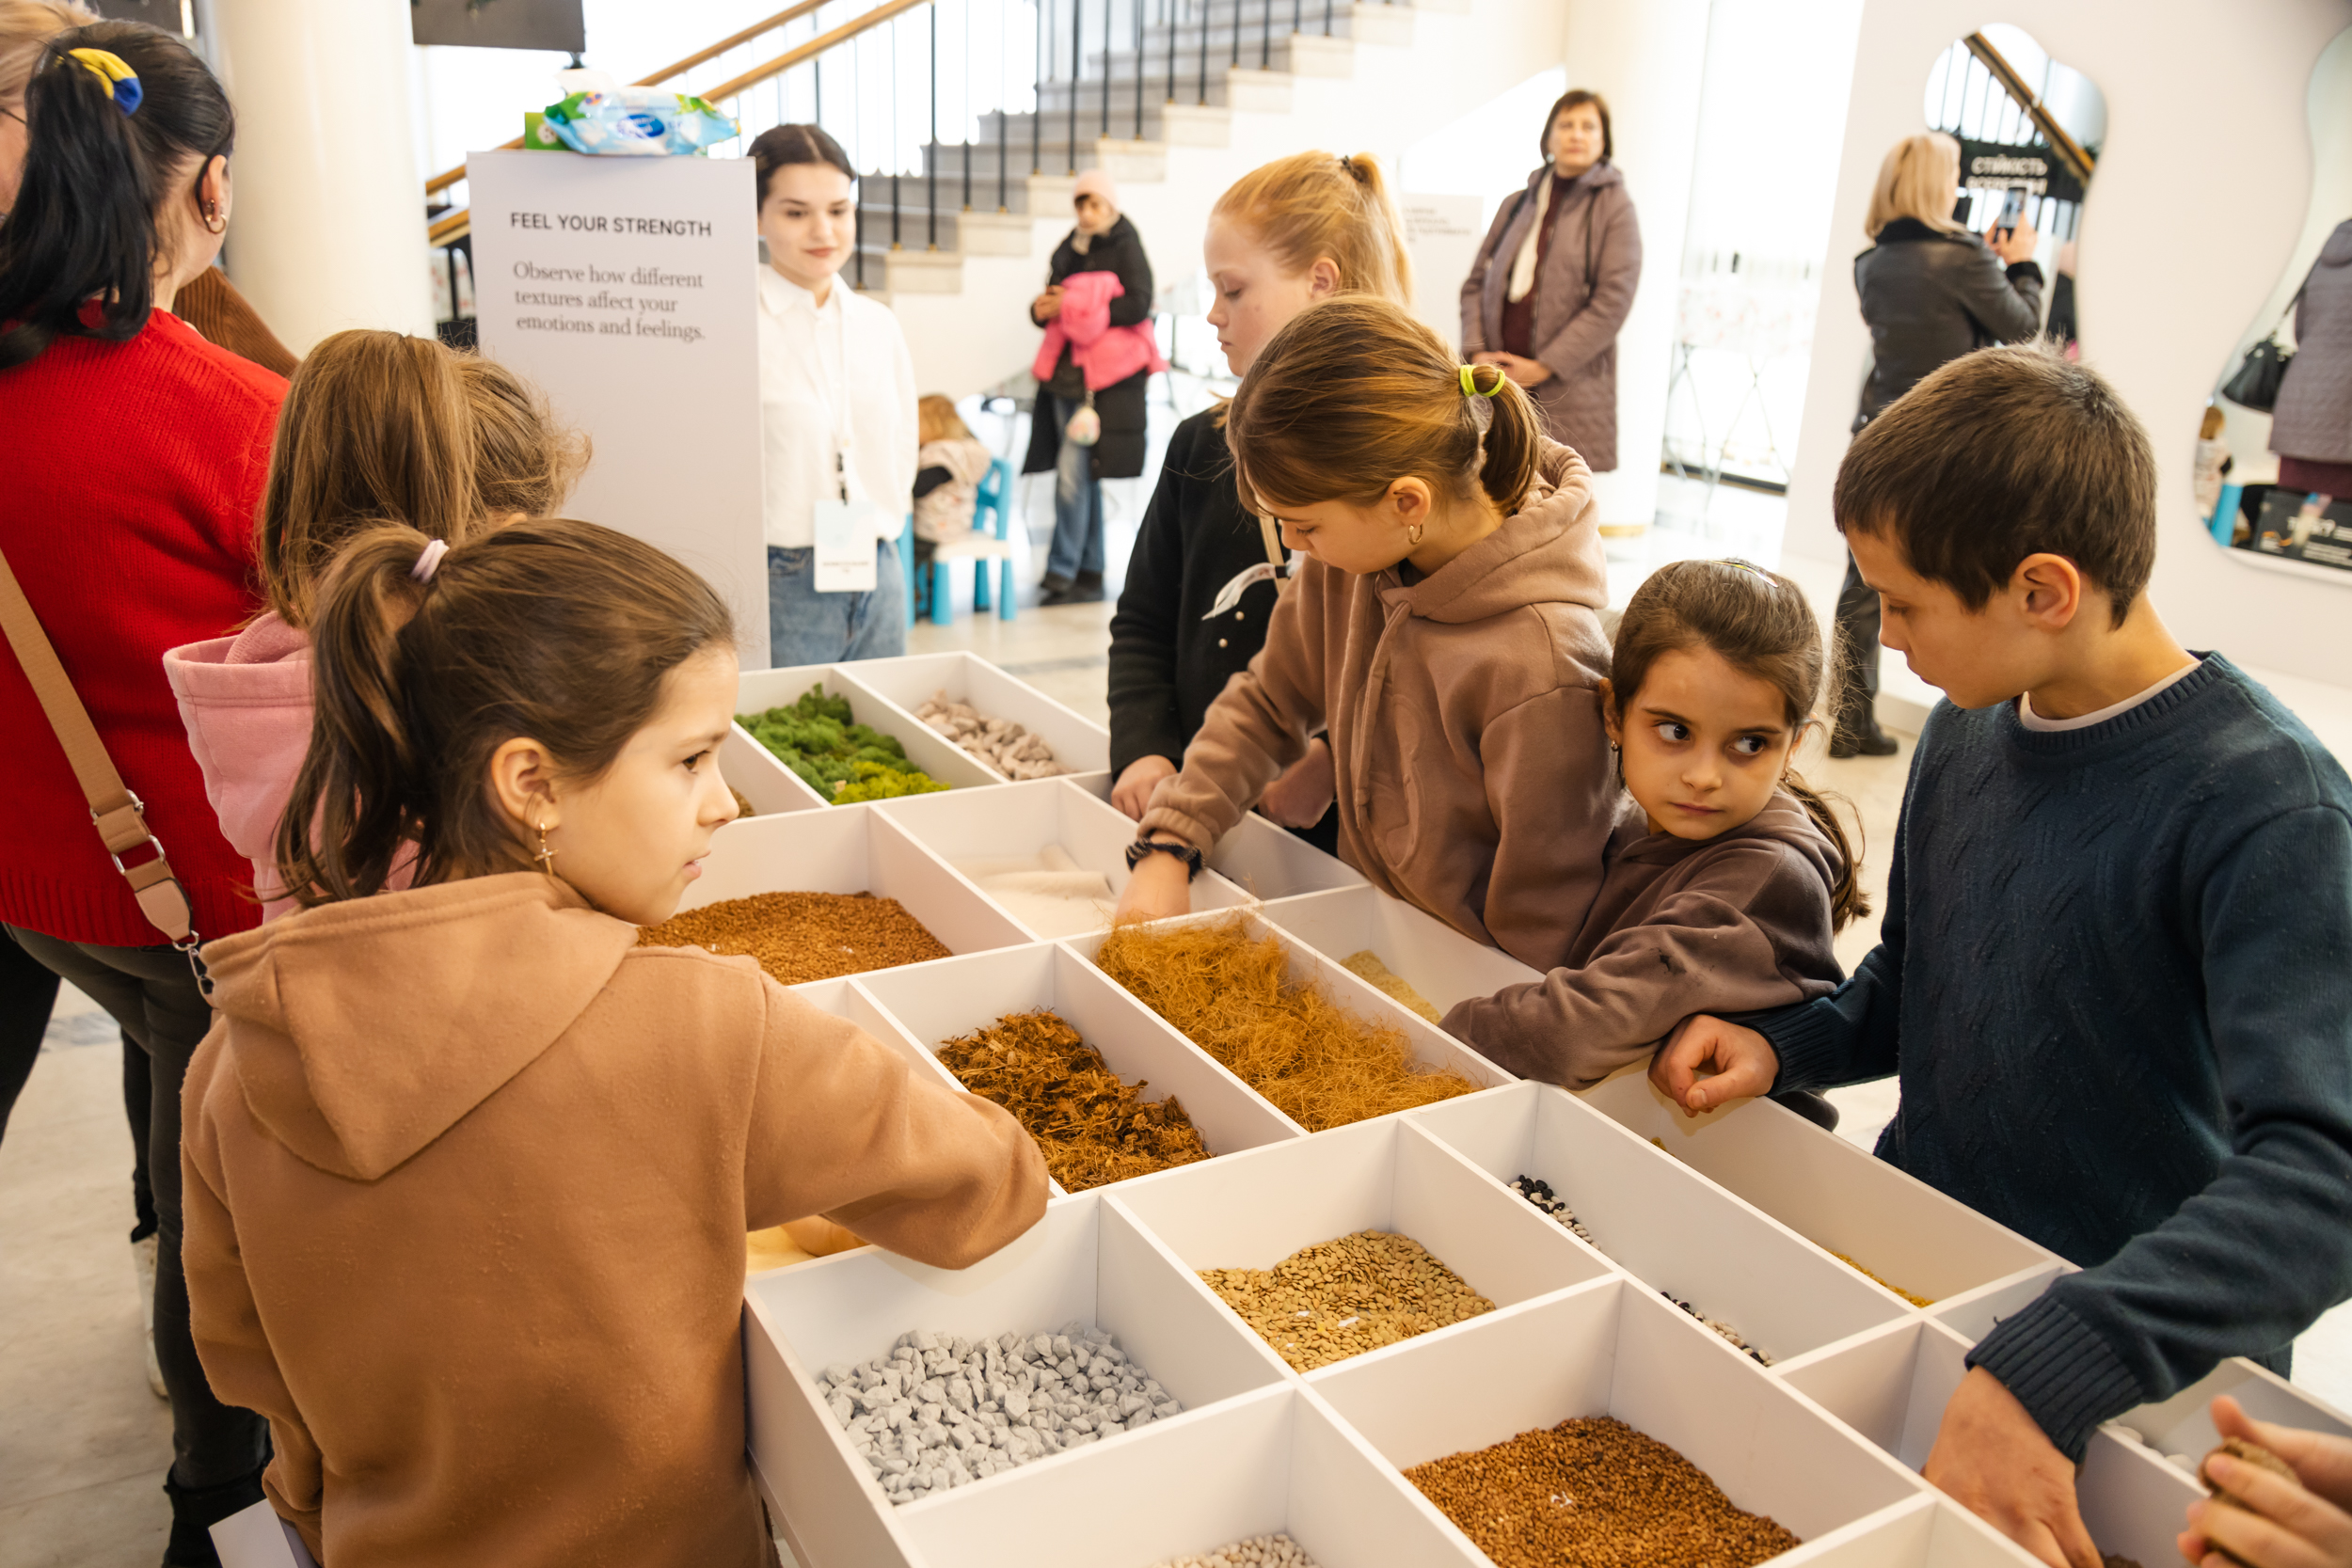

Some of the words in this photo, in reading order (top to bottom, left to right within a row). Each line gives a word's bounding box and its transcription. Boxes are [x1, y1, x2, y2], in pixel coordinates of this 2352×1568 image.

[511, 213, 552, 229] FEEL
[558, 215, 608, 231] YOUR
[613, 217, 712, 236] STRENGTH
[514, 261, 585, 281] Observe
[589, 264, 626, 282] how
[630, 267, 704, 288] different
[515, 291, 583, 307] textures
[587, 291, 633, 309] affect
[638, 298, 678, 315] your
[516, 315, 595, 333] emotions
[598, 318, 632, 335] and
[635, 318, 706, 342] feelings.
